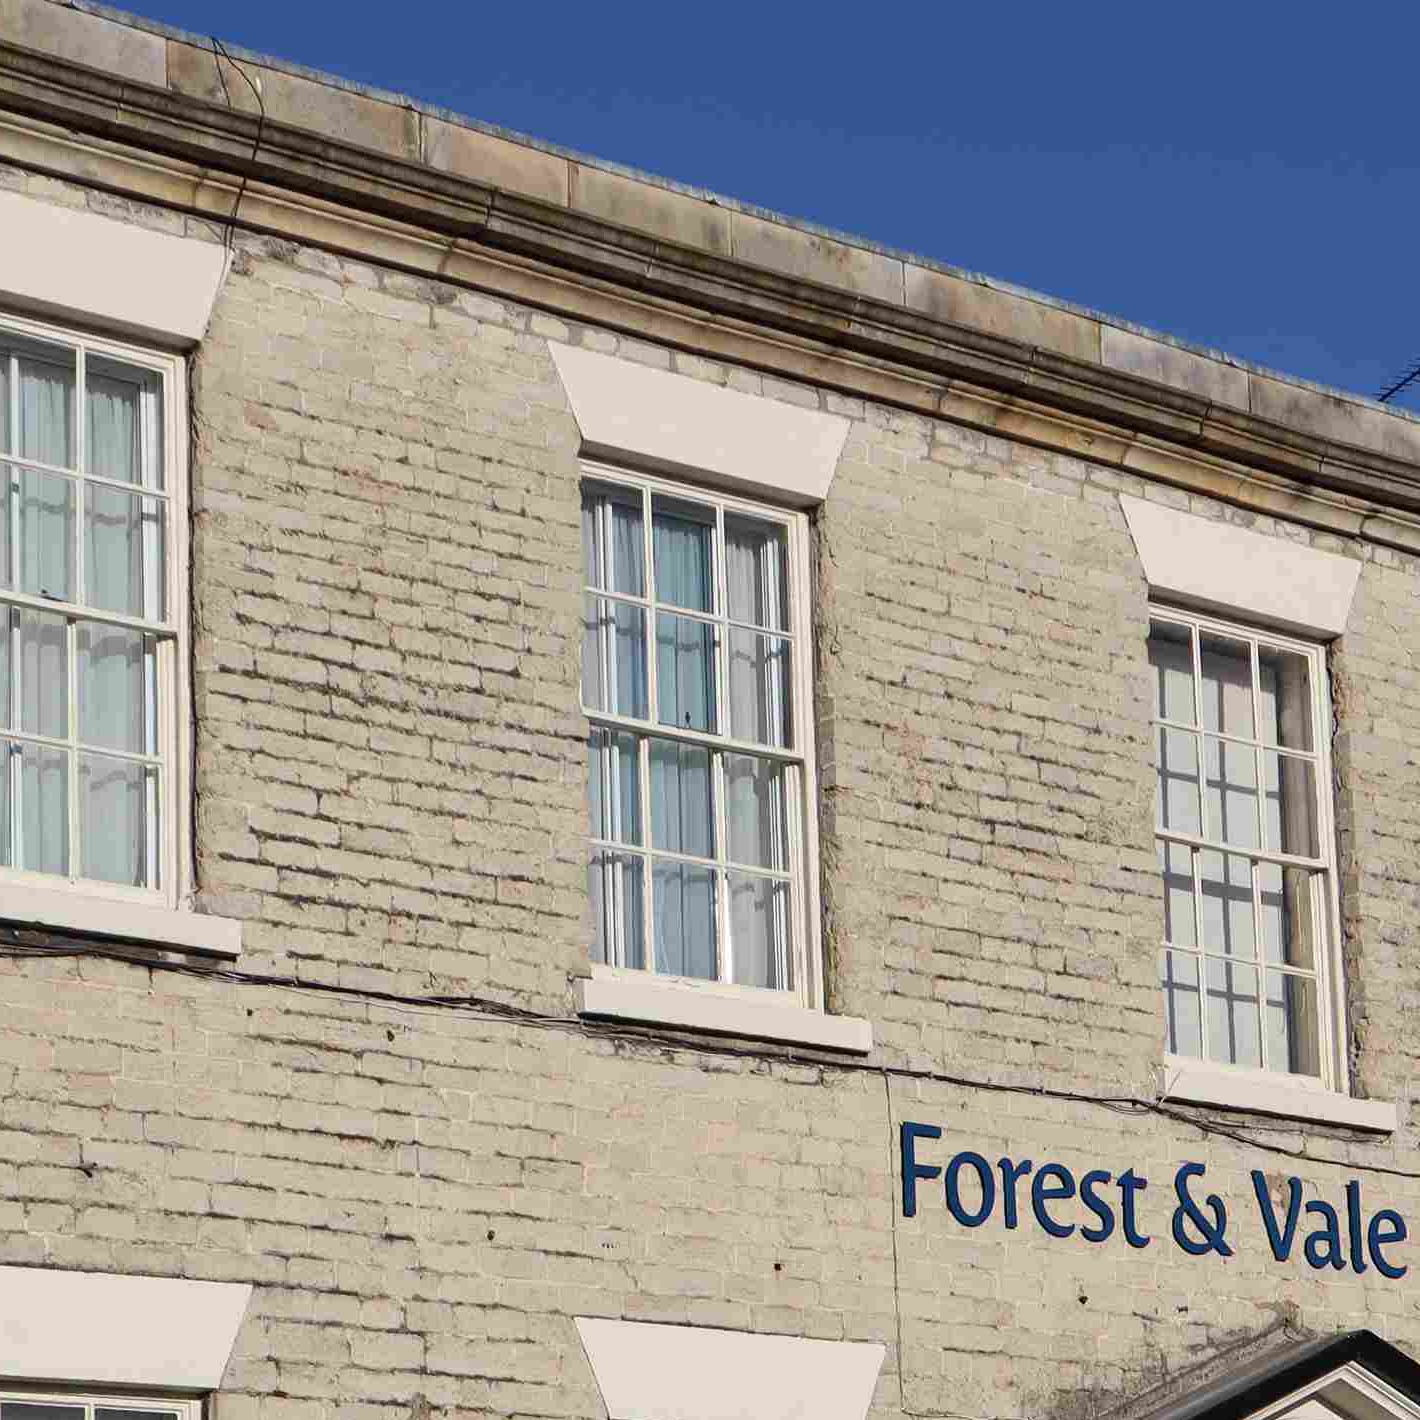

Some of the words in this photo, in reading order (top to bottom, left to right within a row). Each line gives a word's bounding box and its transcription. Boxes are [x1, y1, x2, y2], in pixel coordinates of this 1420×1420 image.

[900, 1121, 1149, 1249] Forest
[1172, 1163, 1232, 1257] &
[1251, 1168, 1408, 1279] Vale
